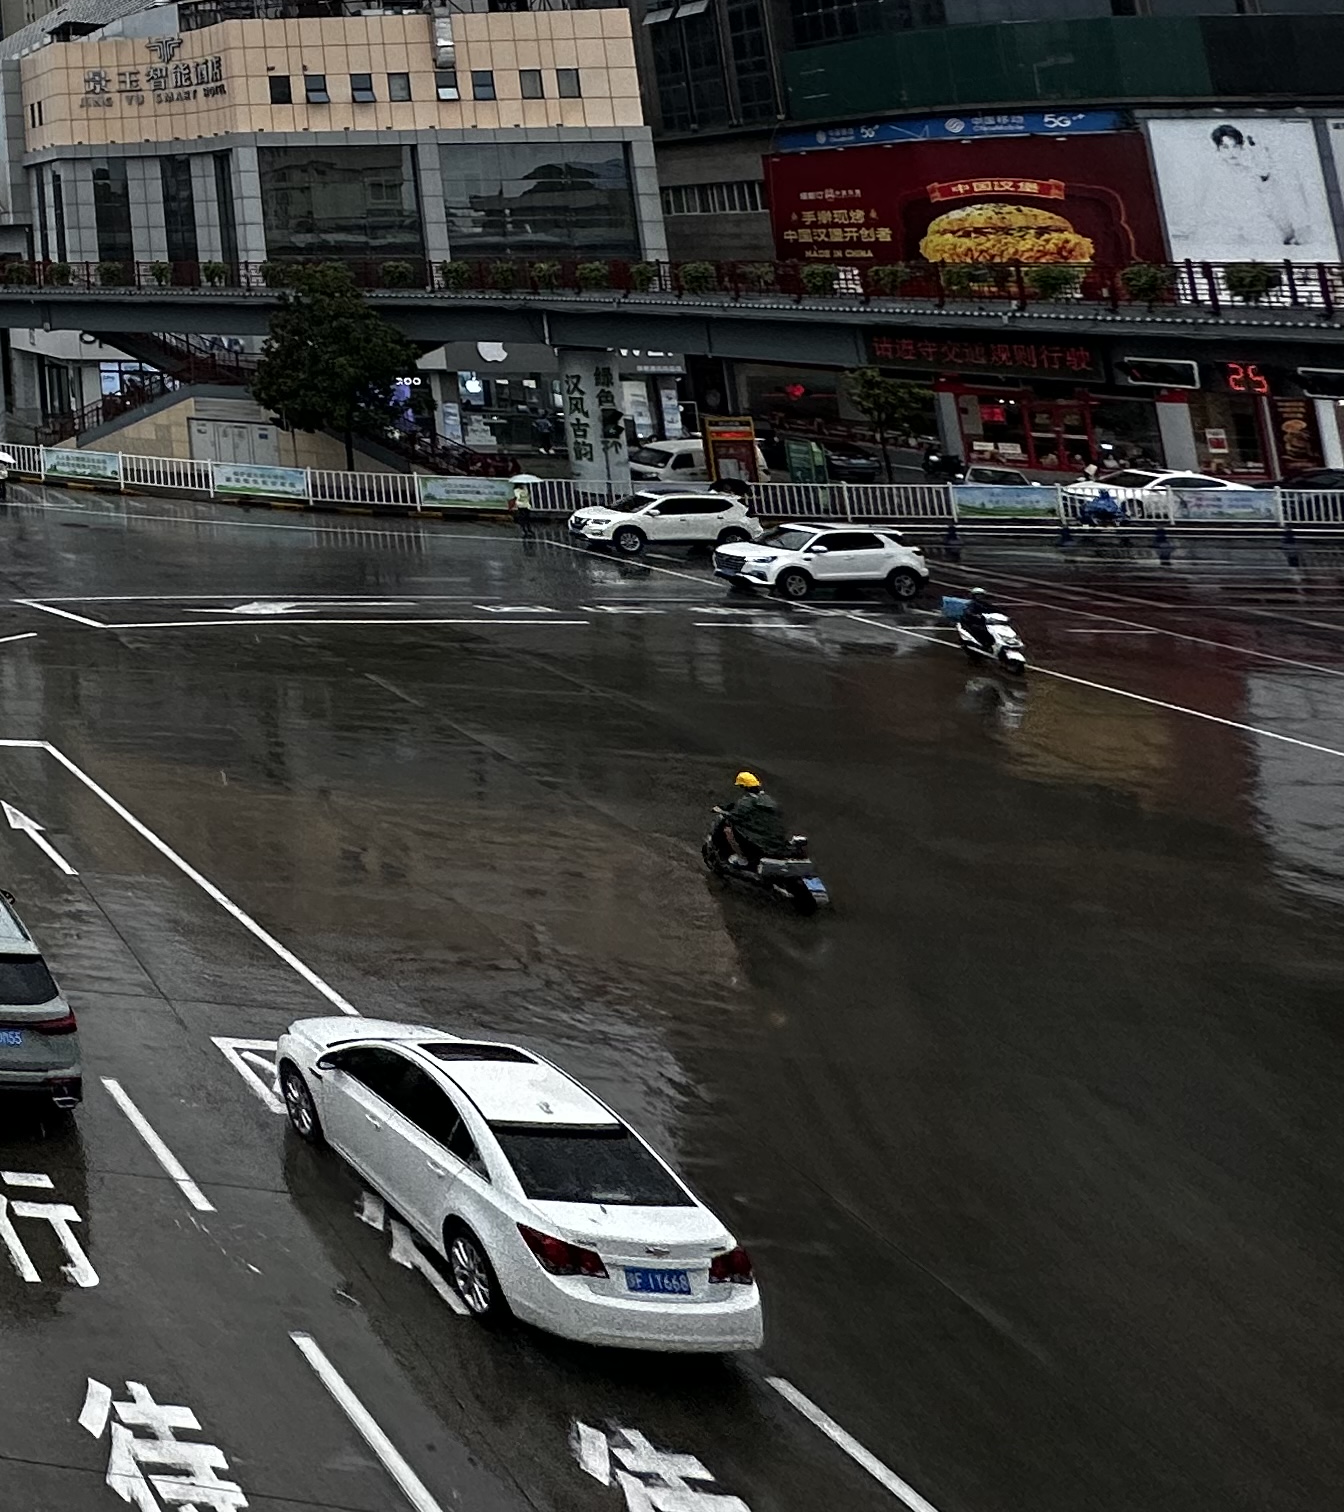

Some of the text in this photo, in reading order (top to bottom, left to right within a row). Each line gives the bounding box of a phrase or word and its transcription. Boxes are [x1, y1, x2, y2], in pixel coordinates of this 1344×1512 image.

[951, 180, 1039, 193] 中国汉堡
[783, 227, 893, 243] 中国汉堡开创者
[872, 336, 1094, 372] 请遵守交通规则行驶
[1228, 362, 1269, 393] 25
[565, 374, 594, 462] 汉风古韵
